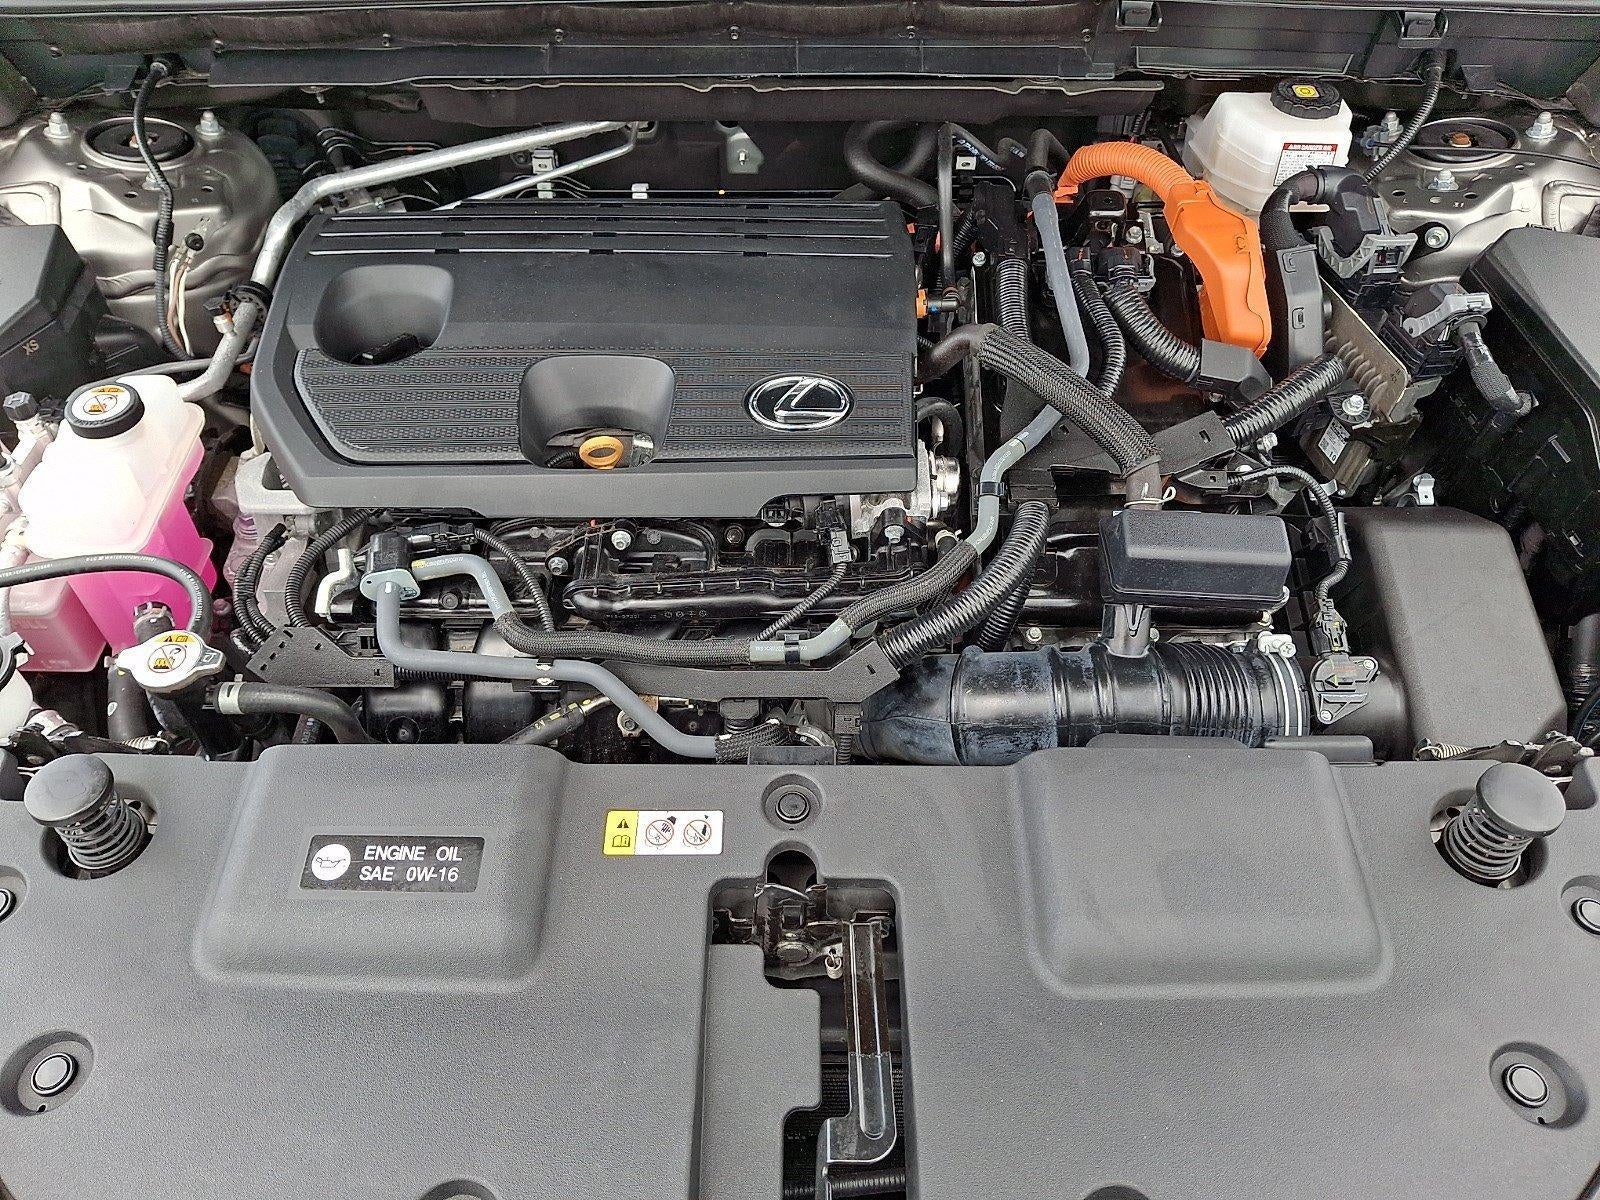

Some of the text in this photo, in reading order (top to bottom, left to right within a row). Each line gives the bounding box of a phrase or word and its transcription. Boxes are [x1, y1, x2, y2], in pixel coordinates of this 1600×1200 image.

[363, 845, 463, 862] ENGINE OIL
[358, 866, 460, 882] SAE 0W-16
